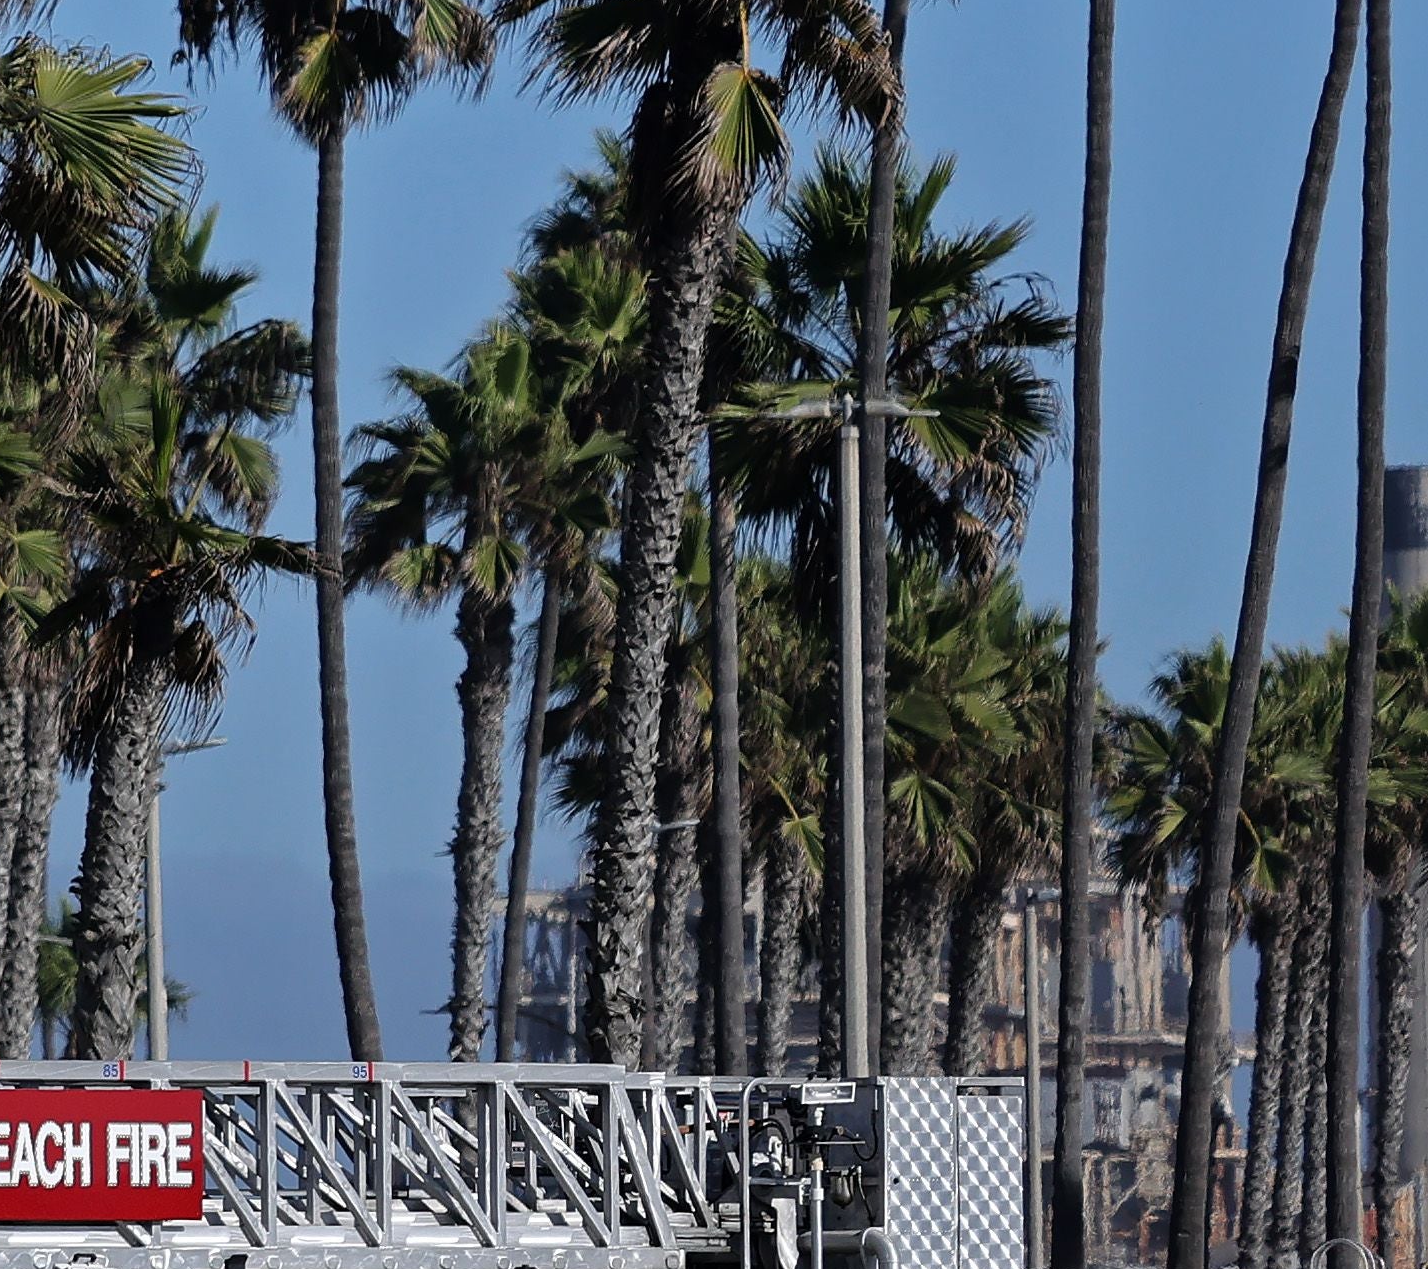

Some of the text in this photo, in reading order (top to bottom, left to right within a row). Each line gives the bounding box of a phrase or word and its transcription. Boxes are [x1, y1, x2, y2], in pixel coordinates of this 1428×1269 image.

[102, 1062, 118, 1078] 85
[352, 1063, 369, 1079] 95
[106, 1121, 195, 1188] FIRE
